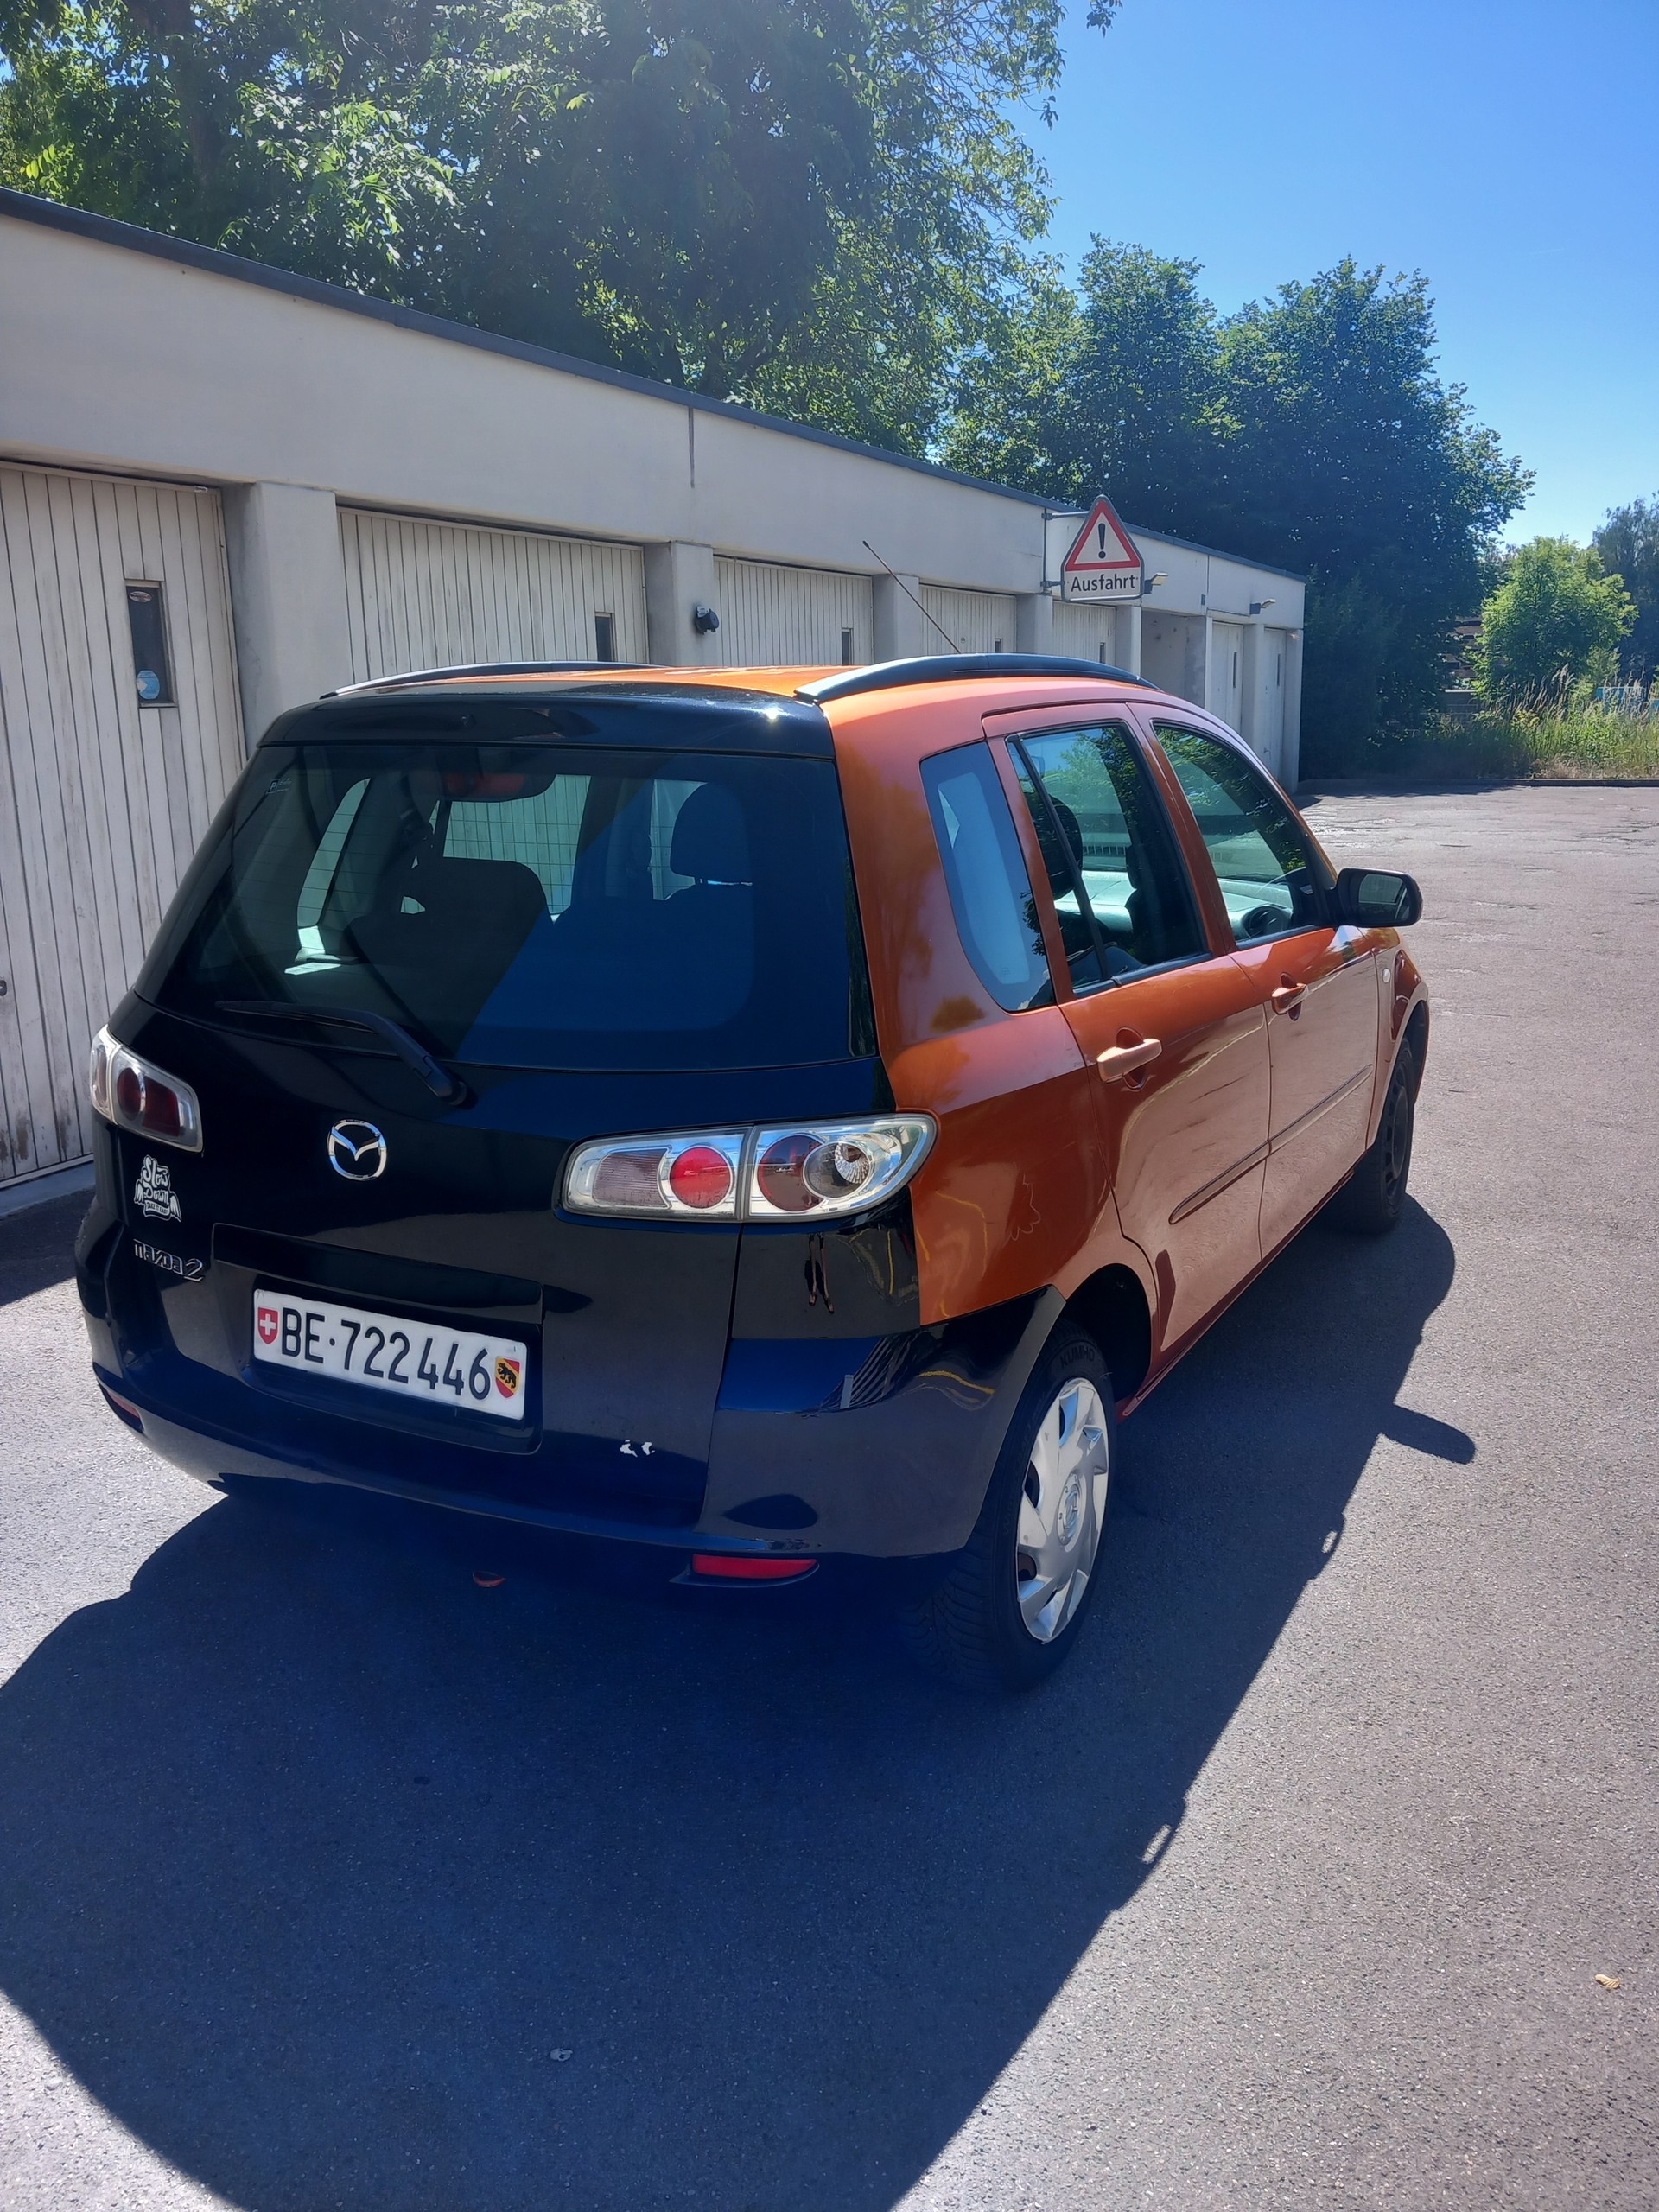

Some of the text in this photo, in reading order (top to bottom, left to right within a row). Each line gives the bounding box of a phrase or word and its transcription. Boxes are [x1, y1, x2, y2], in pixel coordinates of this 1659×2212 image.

[1070, 573, 1135, 592] Ausfahrt
[142, 1156, 168, 1189] Slow
[142, 1179, 170, 1205] Down
[1060, 1344, 1095, 1369] KUMHO
